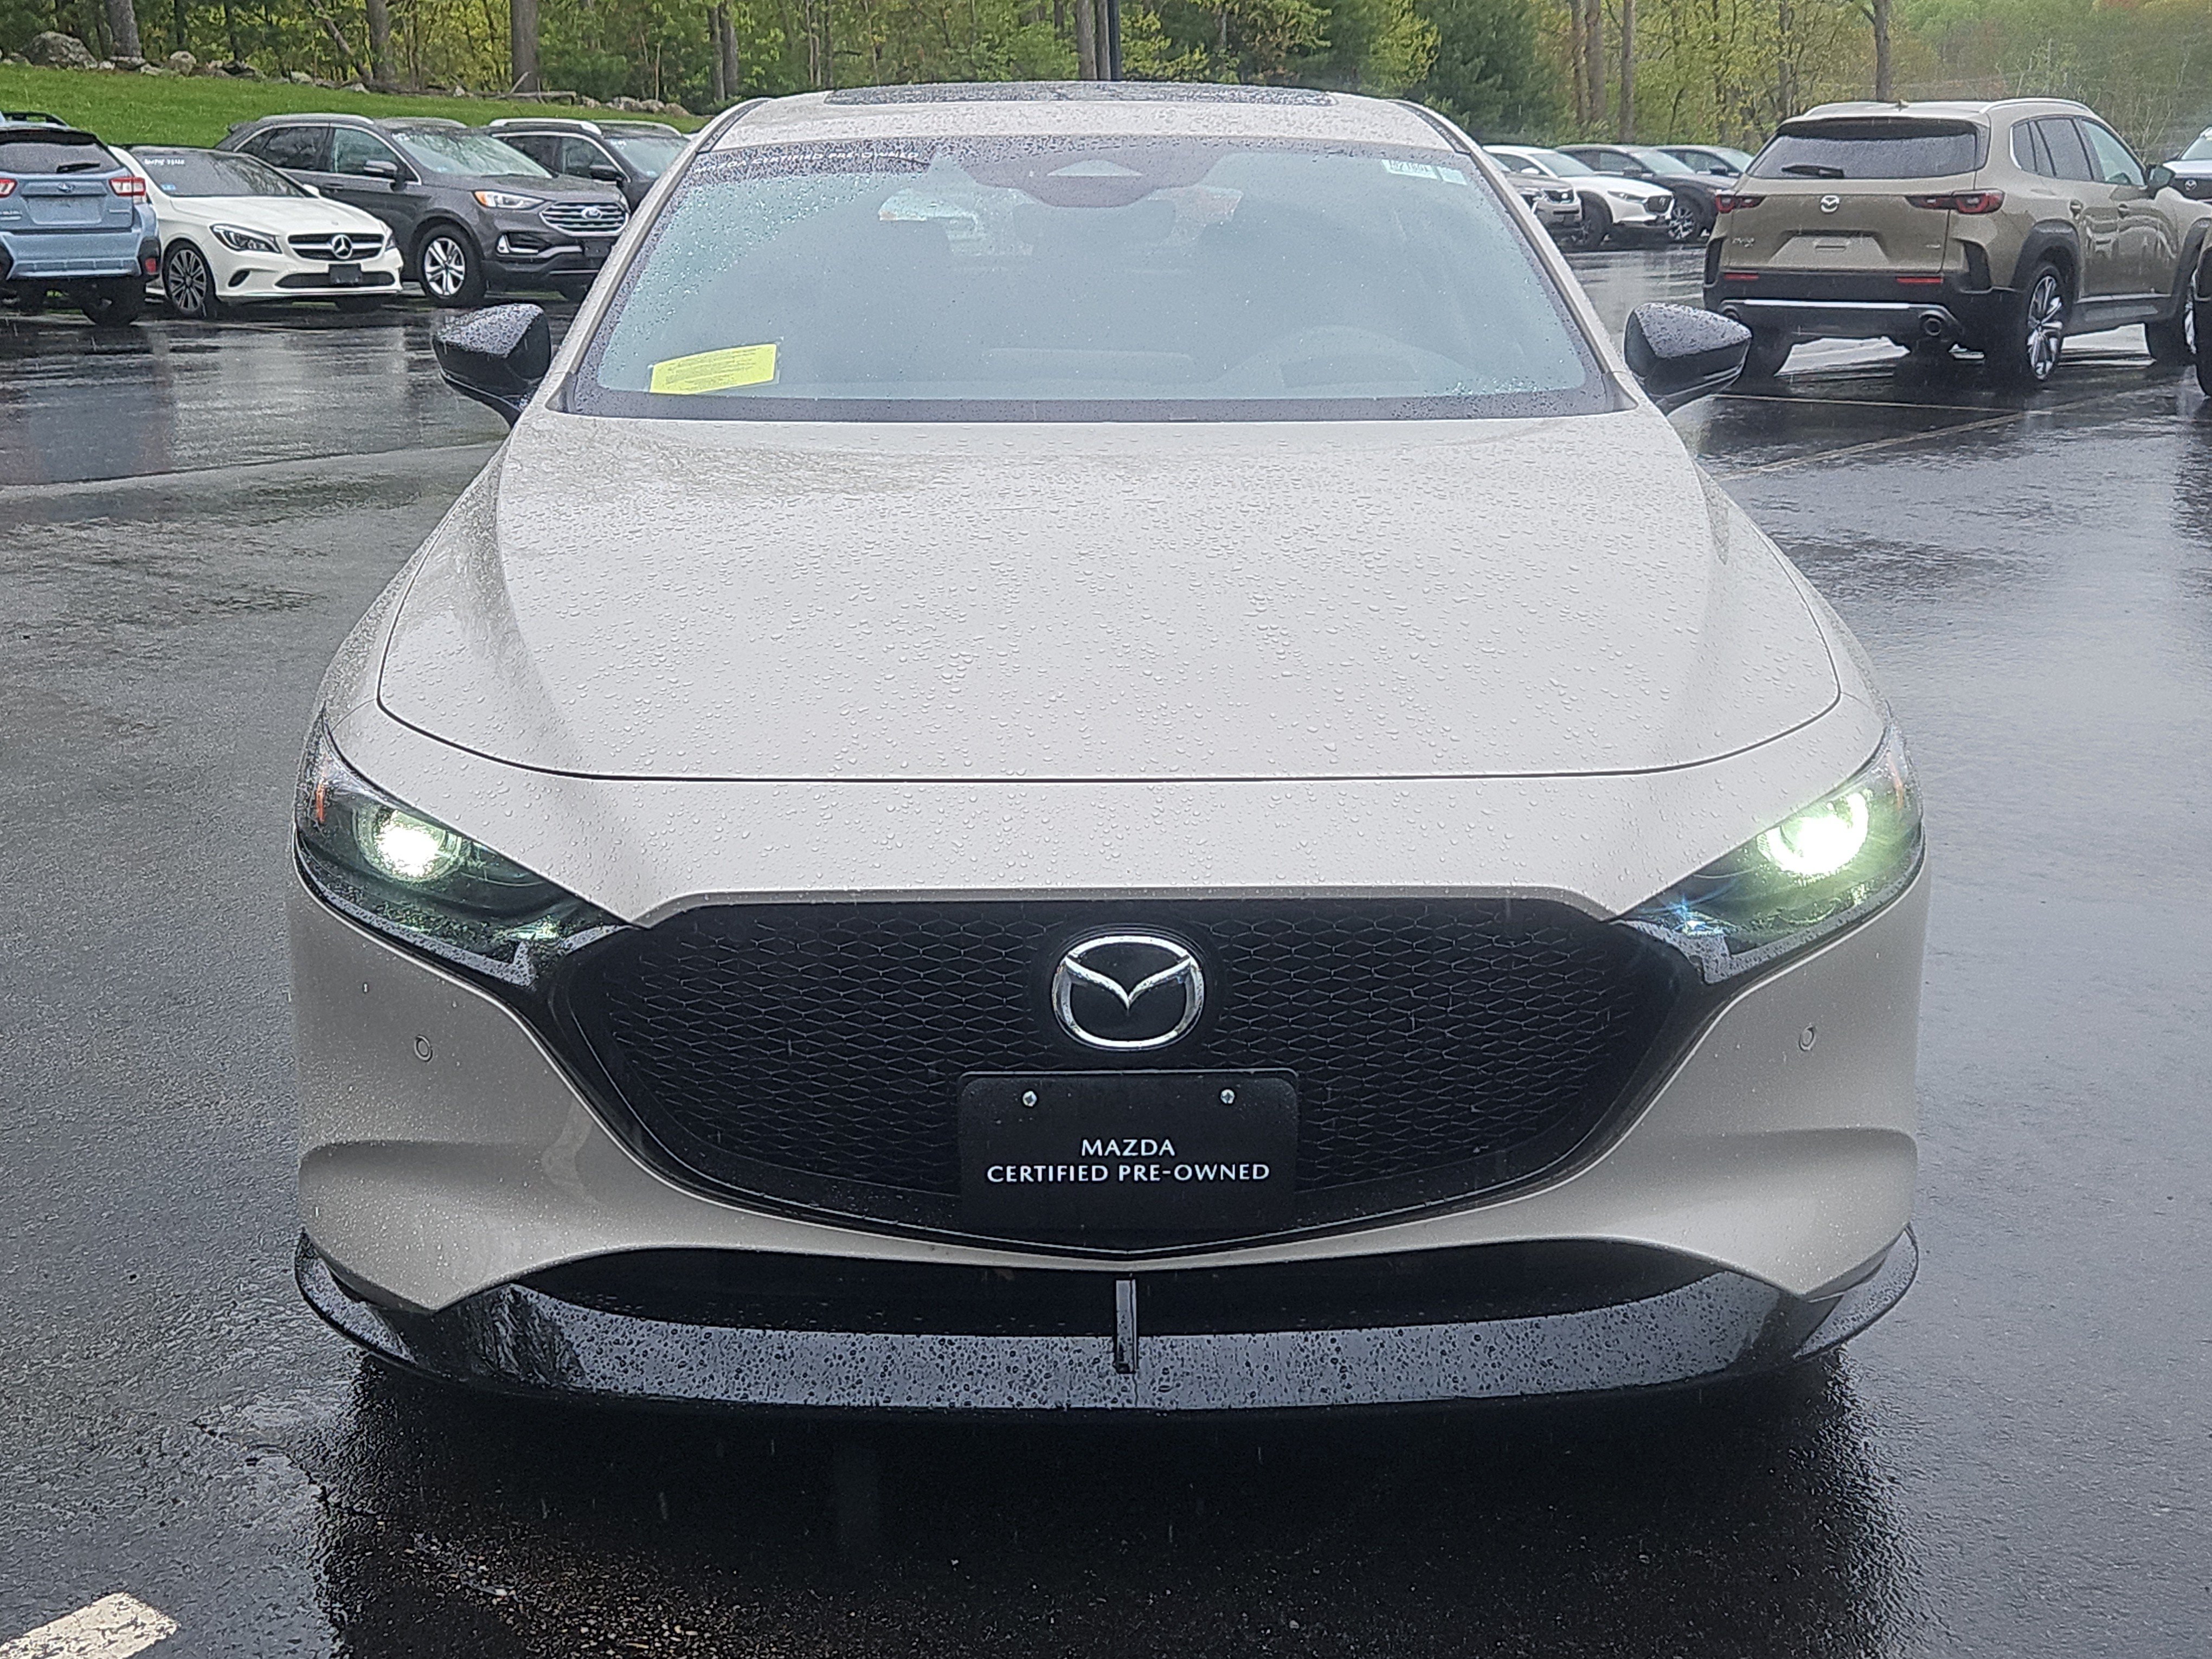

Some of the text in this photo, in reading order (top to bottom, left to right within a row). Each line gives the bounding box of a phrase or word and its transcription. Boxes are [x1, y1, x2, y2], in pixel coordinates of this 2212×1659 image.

[1082, 1139, 1175, 1156] MAZDA
[987, 1164, 1269, 1182] CERTIFIED PRE-OWNED
